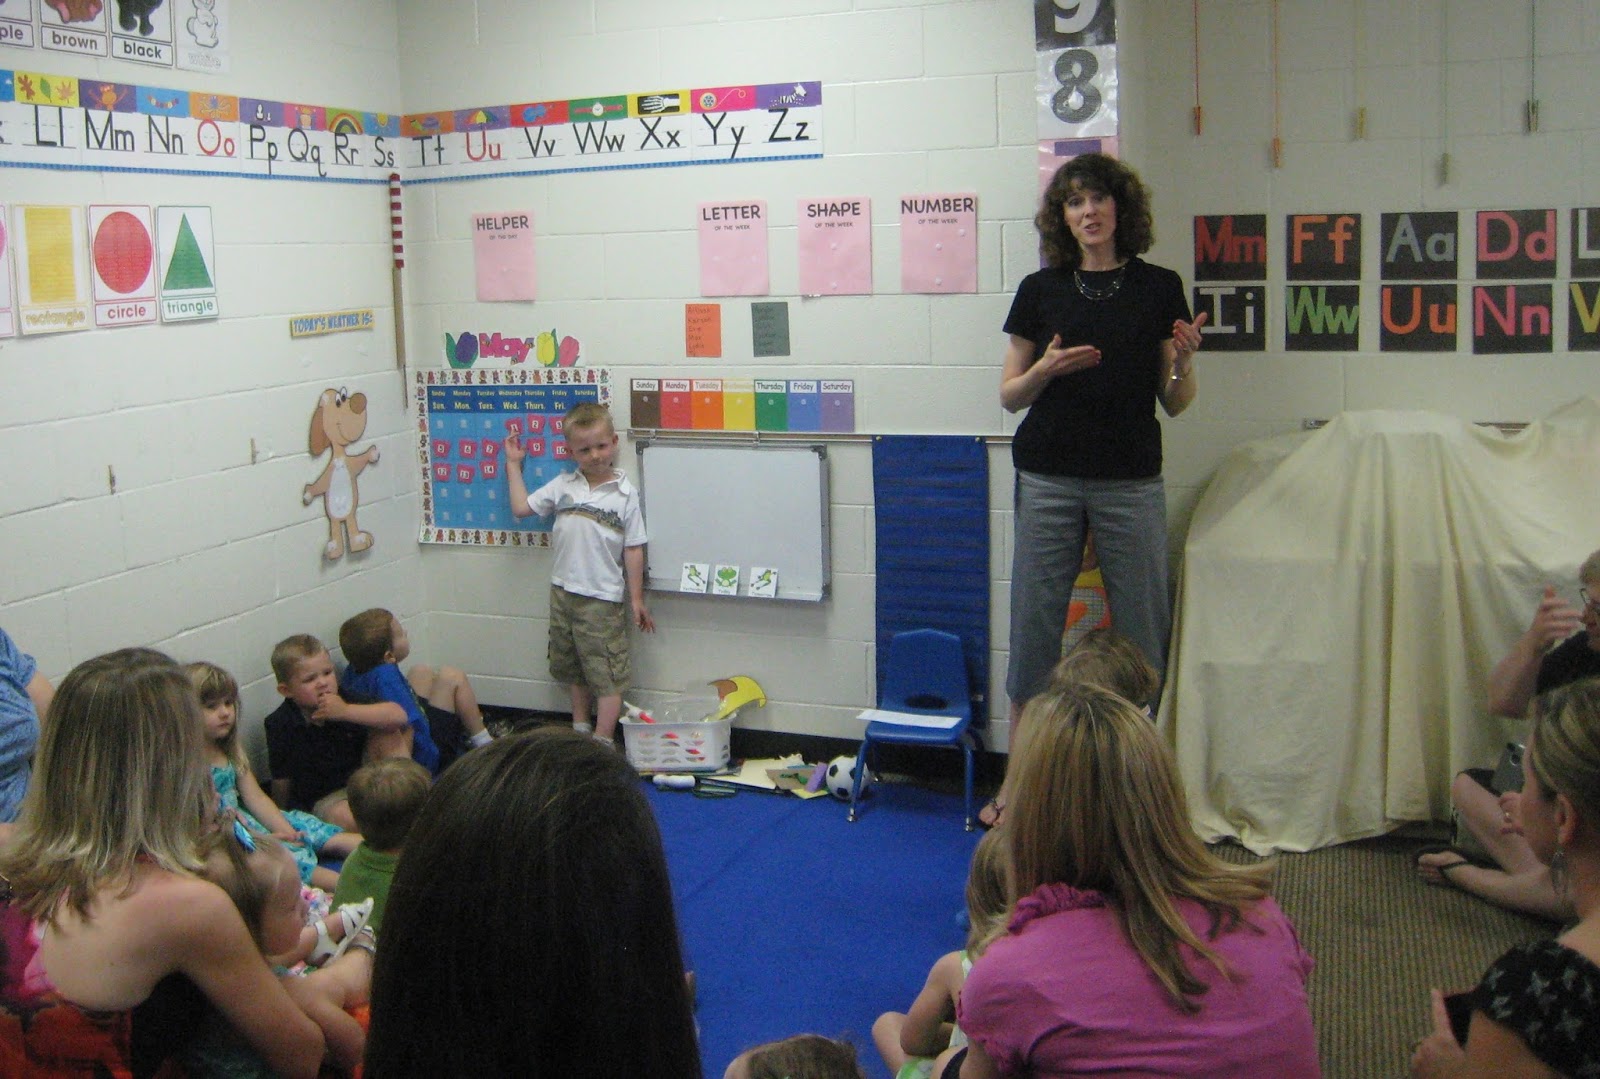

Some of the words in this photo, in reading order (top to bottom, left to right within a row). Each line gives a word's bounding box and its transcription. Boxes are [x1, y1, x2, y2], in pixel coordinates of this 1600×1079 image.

[52, 31, 98, 51] brown
[123, 41, 162, 60] black
[1052, 49, 1102, 124] 8
[34, 104, 64, 148] Ll
[84, 108, 136, 152] Mm
[148, 115, 184, 155] Nn
[197, 119, 235, 157] Oo
[249, 124, 279, 175] Pp
[287, 127, 328, 178] Qq
[334, 133, 359, 166] Rr
[374, 136, 395, 168] Ss
[412, 133, 445, 166] Tt
[465, 129, 501, 162] Uu
[524, 125, 557, 158] Vv
[572, 120, 626, 154] Ww
[639, 116, 682, 150] Xx
[702, 111, 746, 159] Yy
[768, 108, 810, 142] Zz
[702, 204, 761, 221] LETTER
[807, 201, 861, 218] SHAPE
[901, 197, 974, 215] NUMBER
[476, 215, 529, 231] HELPER
[1195, 214, 1266, 264] Mm
[1292, 214, 1356, 264] Ff
[1385, 213, 1456, 263] Aa
[1476, 210, 1556, 262] Dd
[25, 309, 86, 326] rectangle
[107, 304, 147, 319] circle
[166, 299, 214, 317] triangle
[1199, 287, 1255, 335] Ii
[1286, 286, 1359, 334] Ww
[1382, 286, 1456, 334] Uu
[1474, 286, 1550, 336] Nn
[478, 332, 535, 363] May
[636, 381, 656, 390] Sunday
[665, 382, 688, 391] Monday
[695, 382, 719, 391] Tuesday
[756, 381, 784, 391] Thursday
[793, 382, 814, 391] Friday
[822, 381, 851, 391] Saturday
[454, 402, 471, 410] Mon.
[478, 402, 495, 410] Tues.
[503, 402, 519, 410] Wed.
[525, 402, 546, 410] Thurs.
[532, 420, 538, 429] 2
